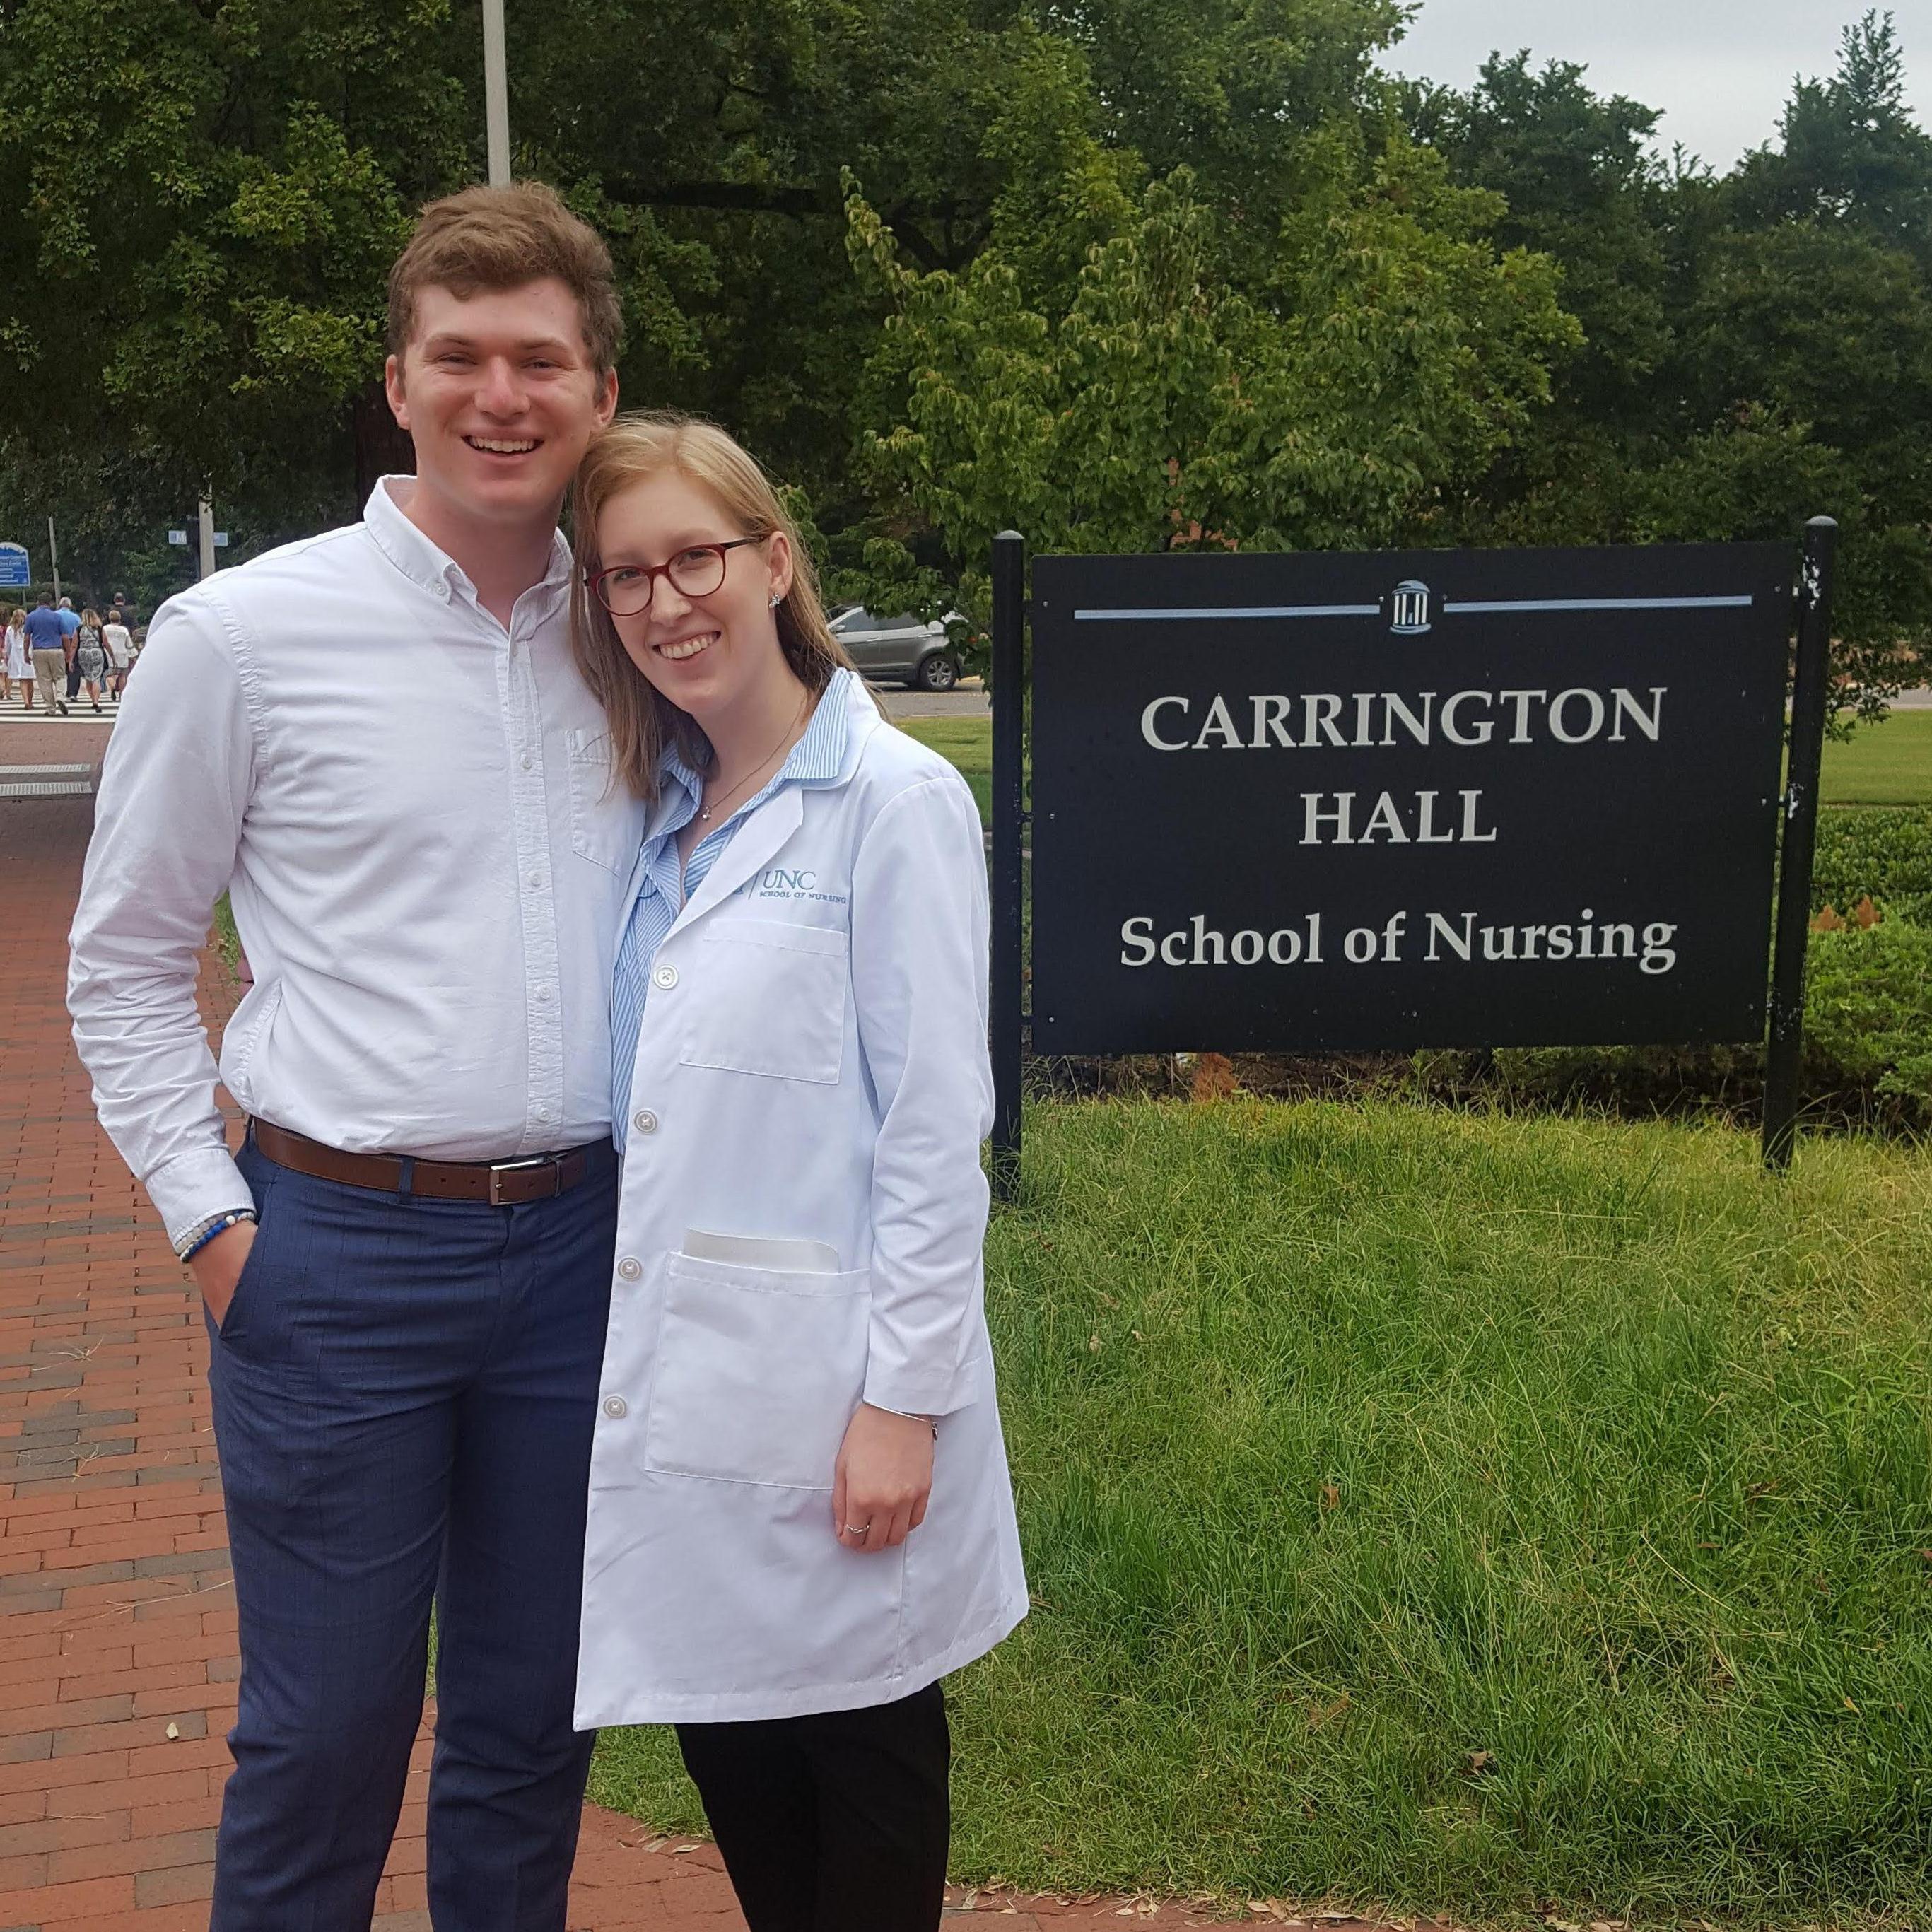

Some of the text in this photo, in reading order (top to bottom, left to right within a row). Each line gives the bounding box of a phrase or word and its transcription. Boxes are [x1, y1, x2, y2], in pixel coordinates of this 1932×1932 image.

[1141, 687, 1668, 751] CARRINGTON
[1299, 790, 1497, 845] HALL
[763, 870, 816, 890] UNC
[809, 893, 847, 904] NURSING
[1120, 908, 1678, 974] School of Nursing
